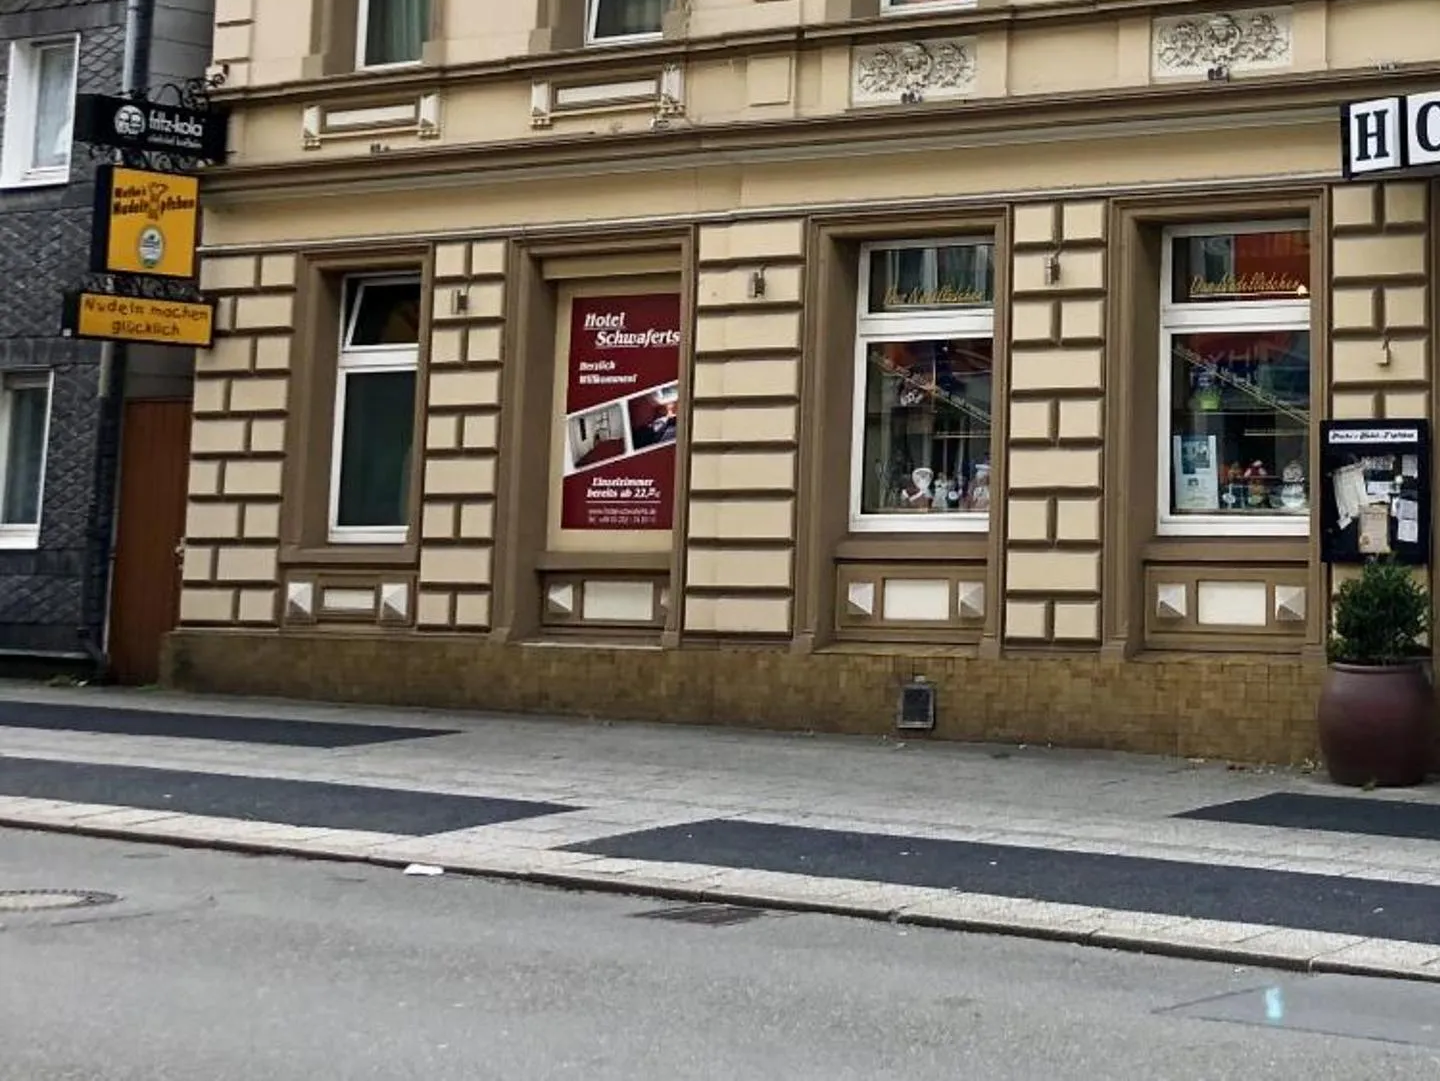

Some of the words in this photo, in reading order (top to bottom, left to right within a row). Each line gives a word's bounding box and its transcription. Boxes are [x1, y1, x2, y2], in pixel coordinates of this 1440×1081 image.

[149, 109, 203, 137] fritz-kola
[584, 312, 626, 328] Hotel
[595, 329, 680, 349] Schwaferts
